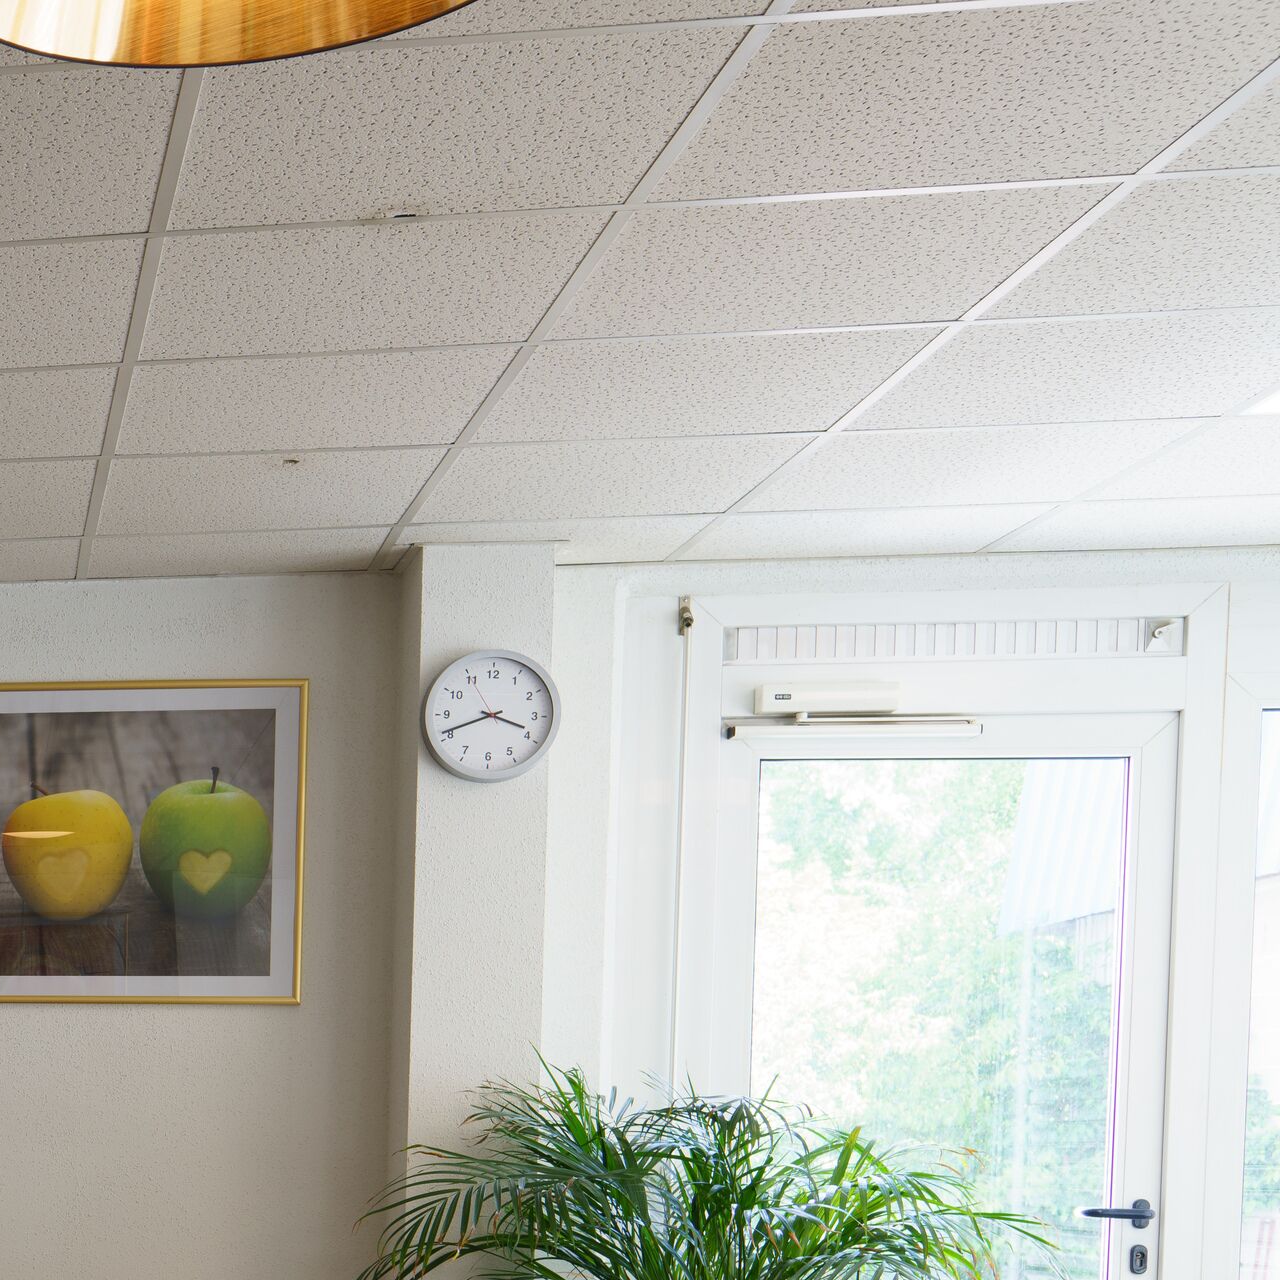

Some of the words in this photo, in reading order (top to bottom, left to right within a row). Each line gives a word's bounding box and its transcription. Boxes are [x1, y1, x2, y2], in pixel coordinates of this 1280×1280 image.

[487, 670, 500, 679] 12
[466, 676, 477, 685] 11
[512, 677, 517, 685] 1
[450, 690, 463, 700] 10
[526, 692, 533, 701] 2
[443, 710, 450, 719] 9
[531, 711, 538, 720] 3
[447, 729, 454, 739] 8
[524, 731, 531, 740] 4
[462, 745, 469, 755] 7
[506, 747, 513, 756] 5
[485, 752, 492, 761] 6
